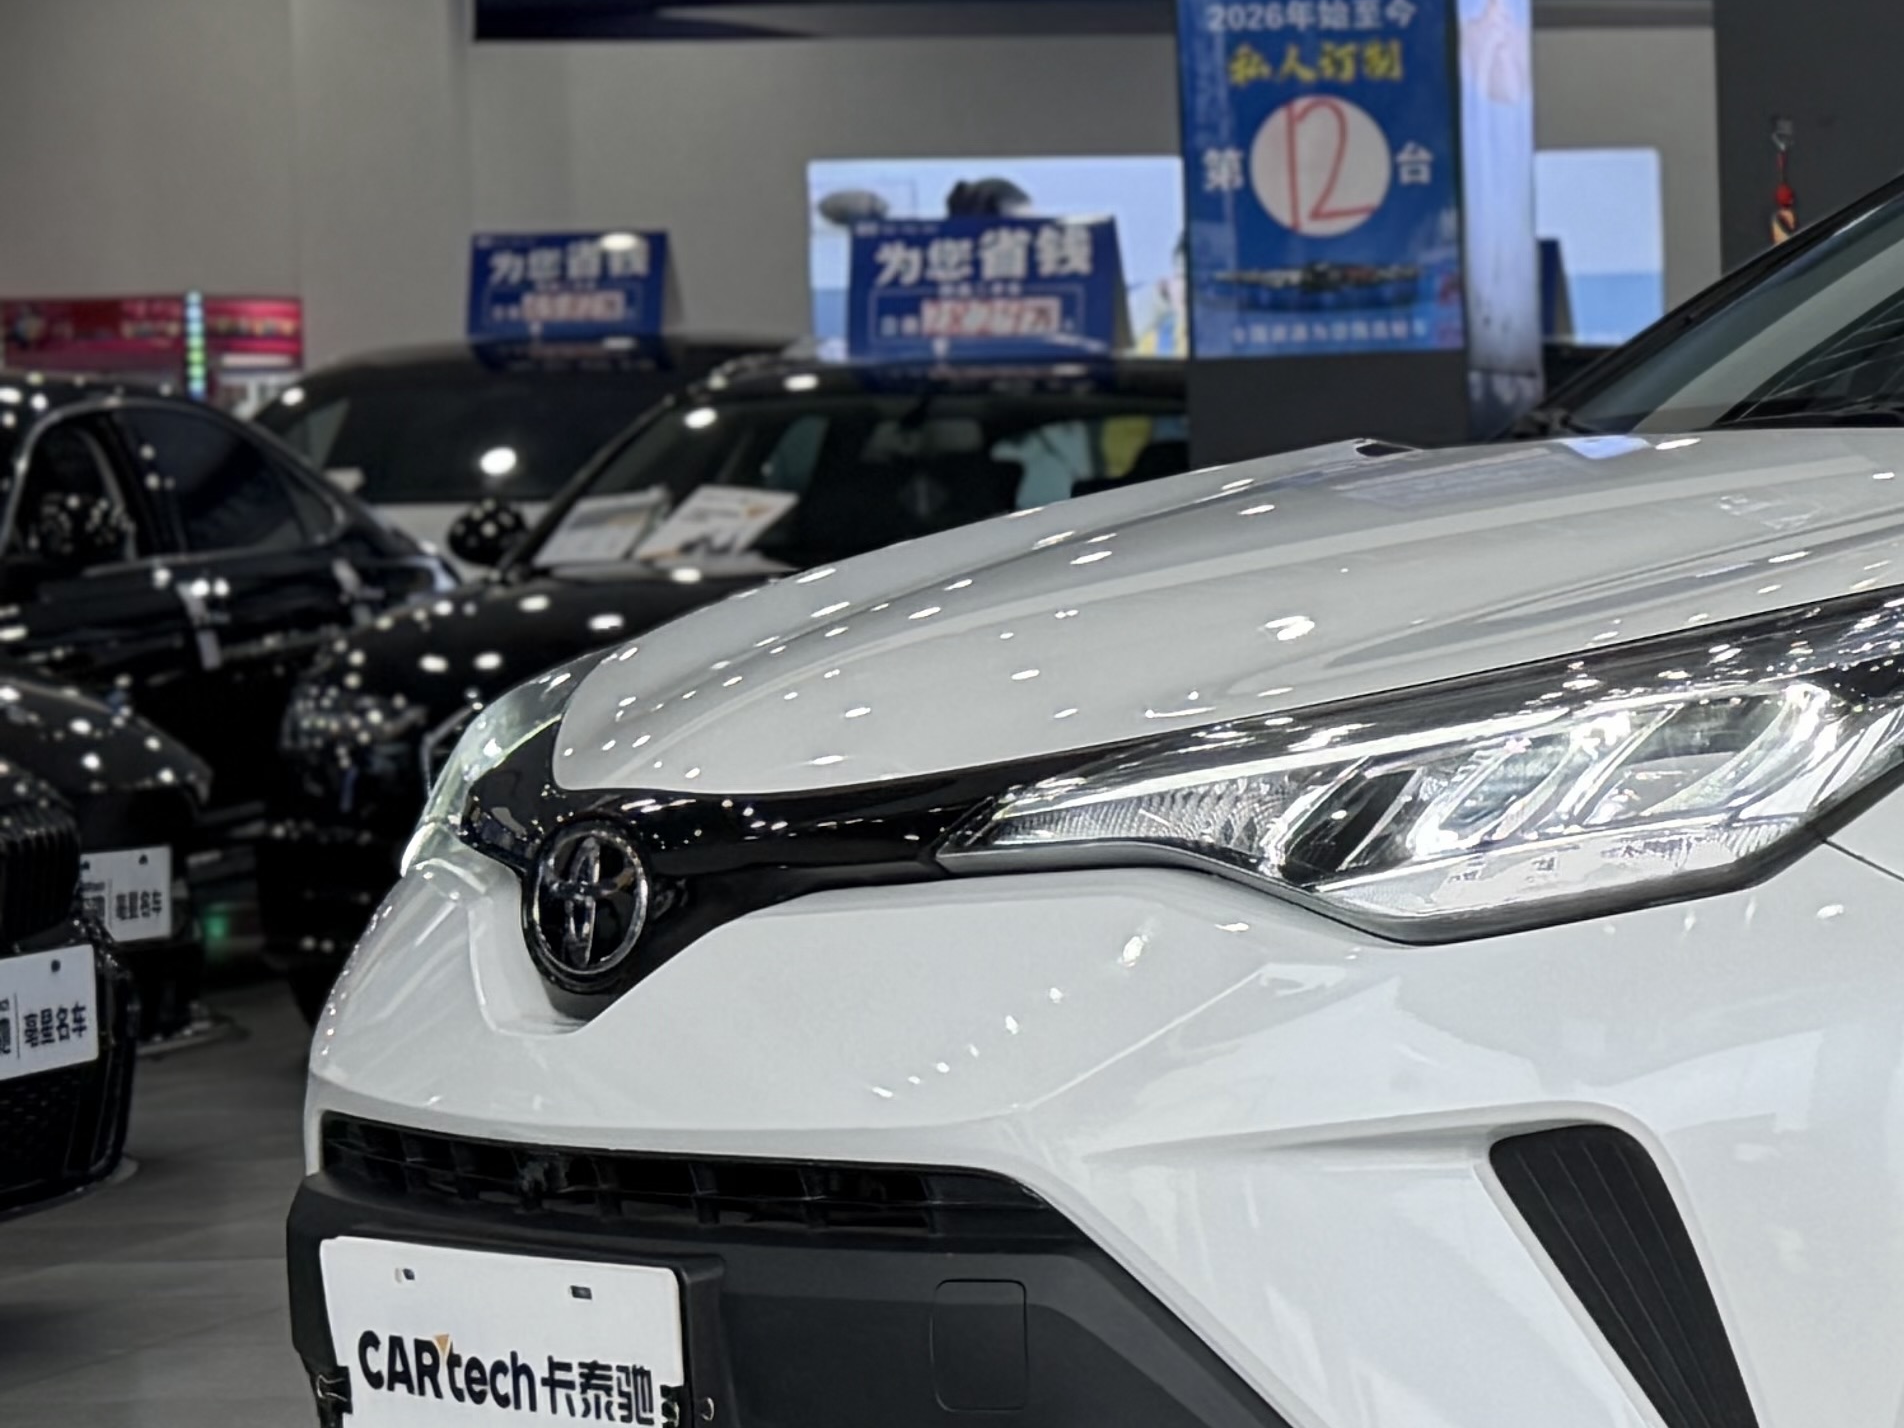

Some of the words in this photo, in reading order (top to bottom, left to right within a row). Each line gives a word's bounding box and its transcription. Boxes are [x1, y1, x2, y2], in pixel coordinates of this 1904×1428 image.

[1203, 147, 1244, 191] 第
[1396, 141, 1433, 185] 台
[1285, 98, 1376, 234] 12
[358, 1330, 537, 1412] CARtech
[540, 1355, 655, 1426] 卡泰驰
